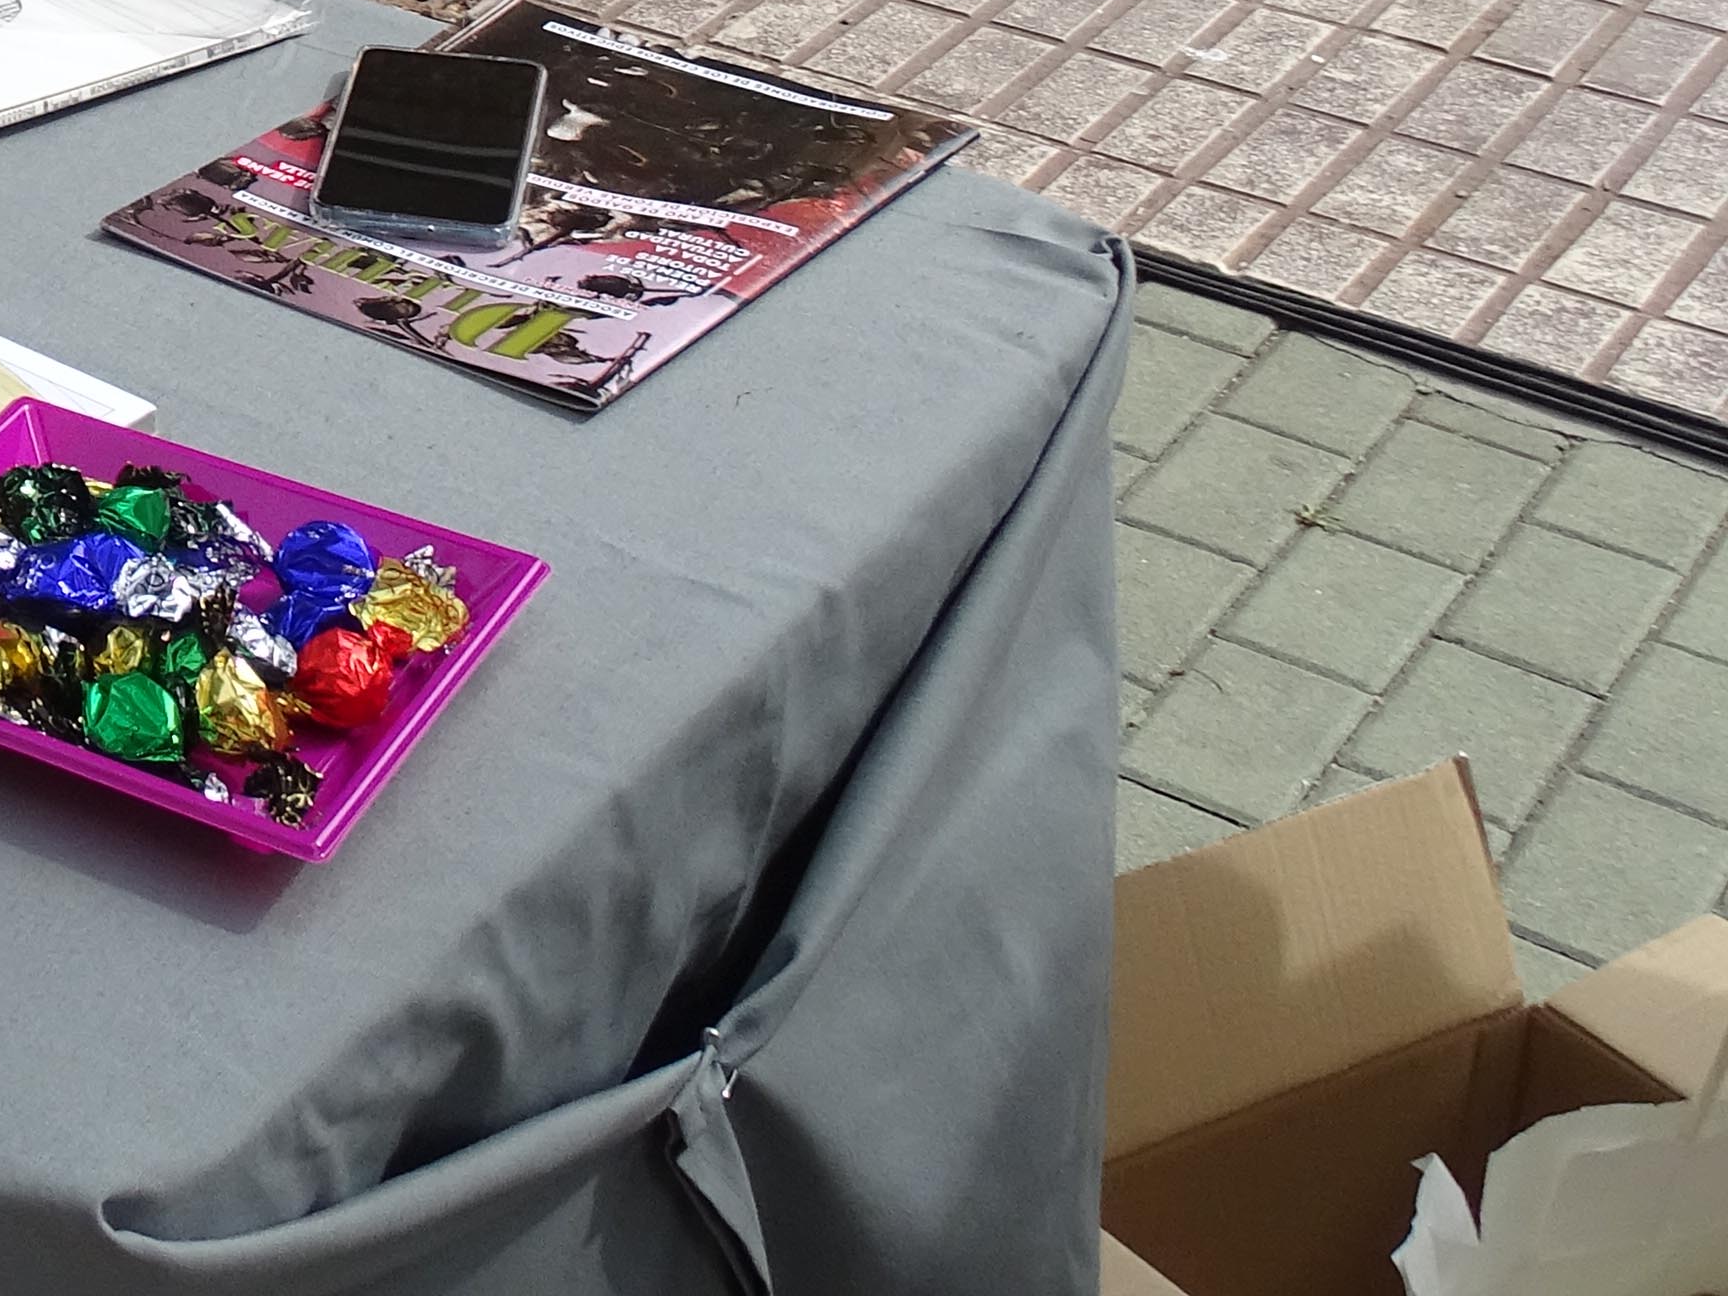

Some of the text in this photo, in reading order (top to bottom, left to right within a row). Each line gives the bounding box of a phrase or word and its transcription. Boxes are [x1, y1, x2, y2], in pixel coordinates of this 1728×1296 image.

[234, 157, 297, 183] JEANS
[236, 192, 301, 218] MANCHA
[639, 206, 658, 214] DE
[688, 207, 794, 232] EXPOSICIÓN
[395, 249, 414, 257] EL
[623, 230, 744, 264] ACTUALIDAD
[656, 228, 752, 256] CULTURAL
[416, 255, 508, 286] ESCRITORES
[601, 263, 617, 272] Y
[605, 254, 712, 285] POEMAS DE
[634, 251, 723, 279] AUTORES
[654, 245, 732, 270] TODA LA
[509, 283, 530, 292] DE
[621, 266, 704, 294] RELATOS
[534, 287, 634, 318] ASOCIACIÓN
